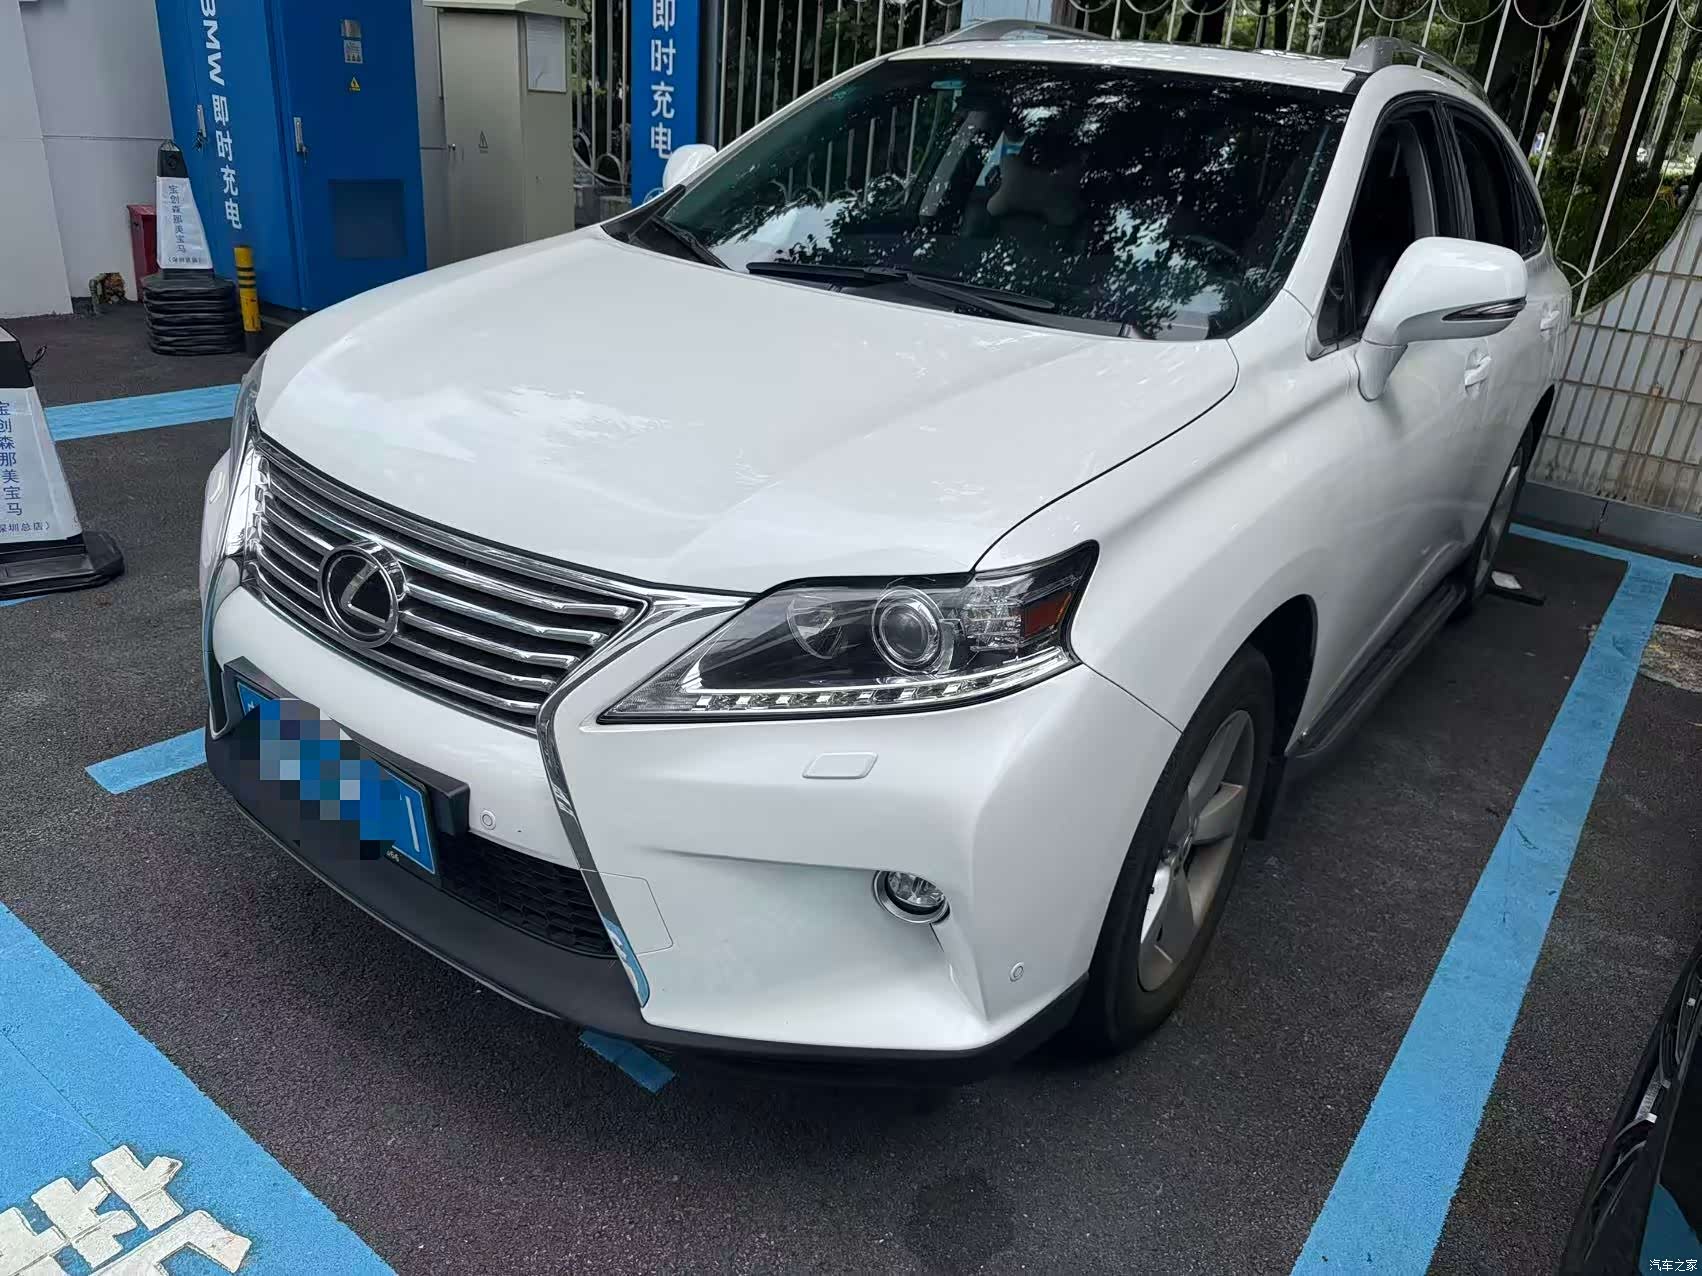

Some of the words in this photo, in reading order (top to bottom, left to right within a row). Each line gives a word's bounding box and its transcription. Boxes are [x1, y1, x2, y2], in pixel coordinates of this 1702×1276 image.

[200, 0, 225, 87] BMW
[650, 0, 677, 160] 即时充电
[212, 94, 242, 230] 即时充电
